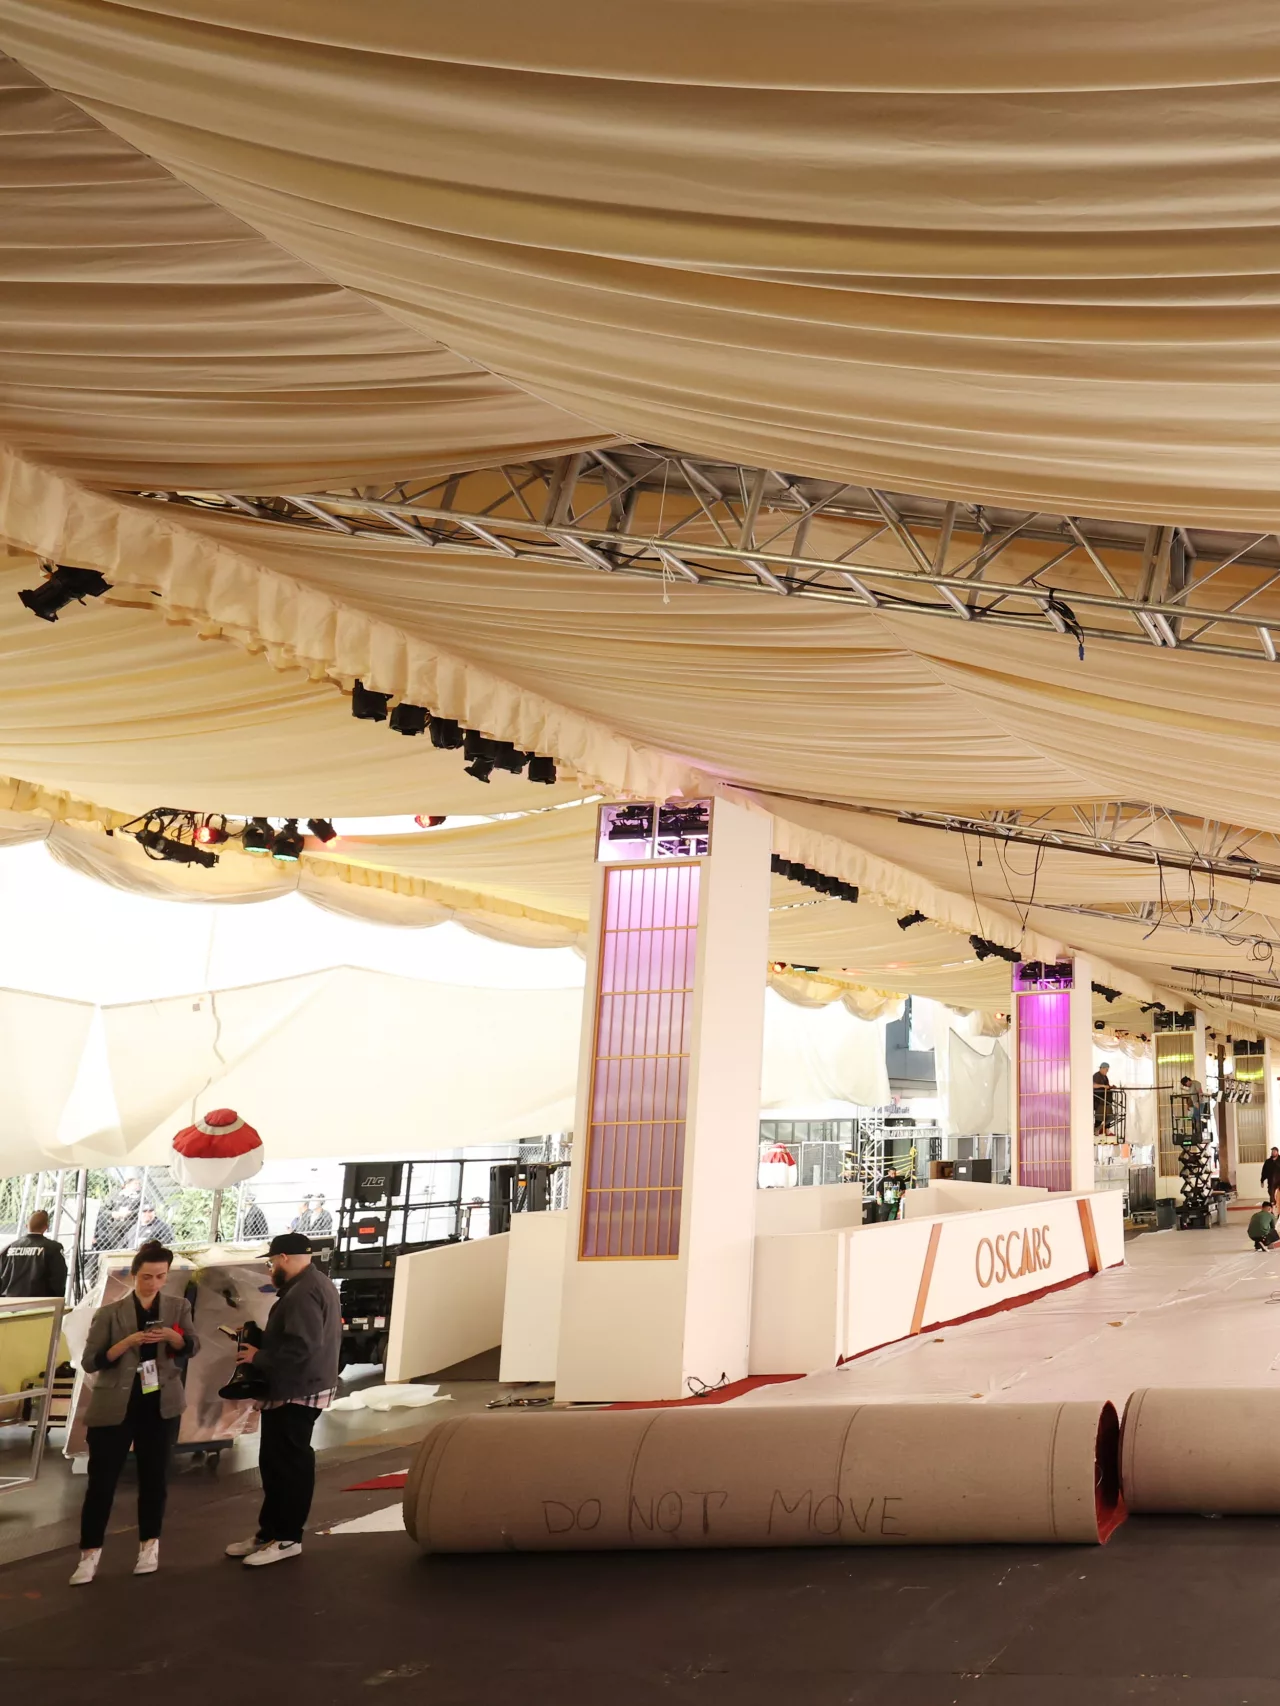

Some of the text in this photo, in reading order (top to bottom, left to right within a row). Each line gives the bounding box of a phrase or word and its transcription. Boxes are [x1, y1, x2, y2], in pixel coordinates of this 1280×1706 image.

[361, 1176, 385, 1187] JLG
[6, 1246, 44, 1257] SECURITY
[975, 1225, 1052, 1288] OSCARS
[542, 1488, 907, 1536] DO NOT MOVE
